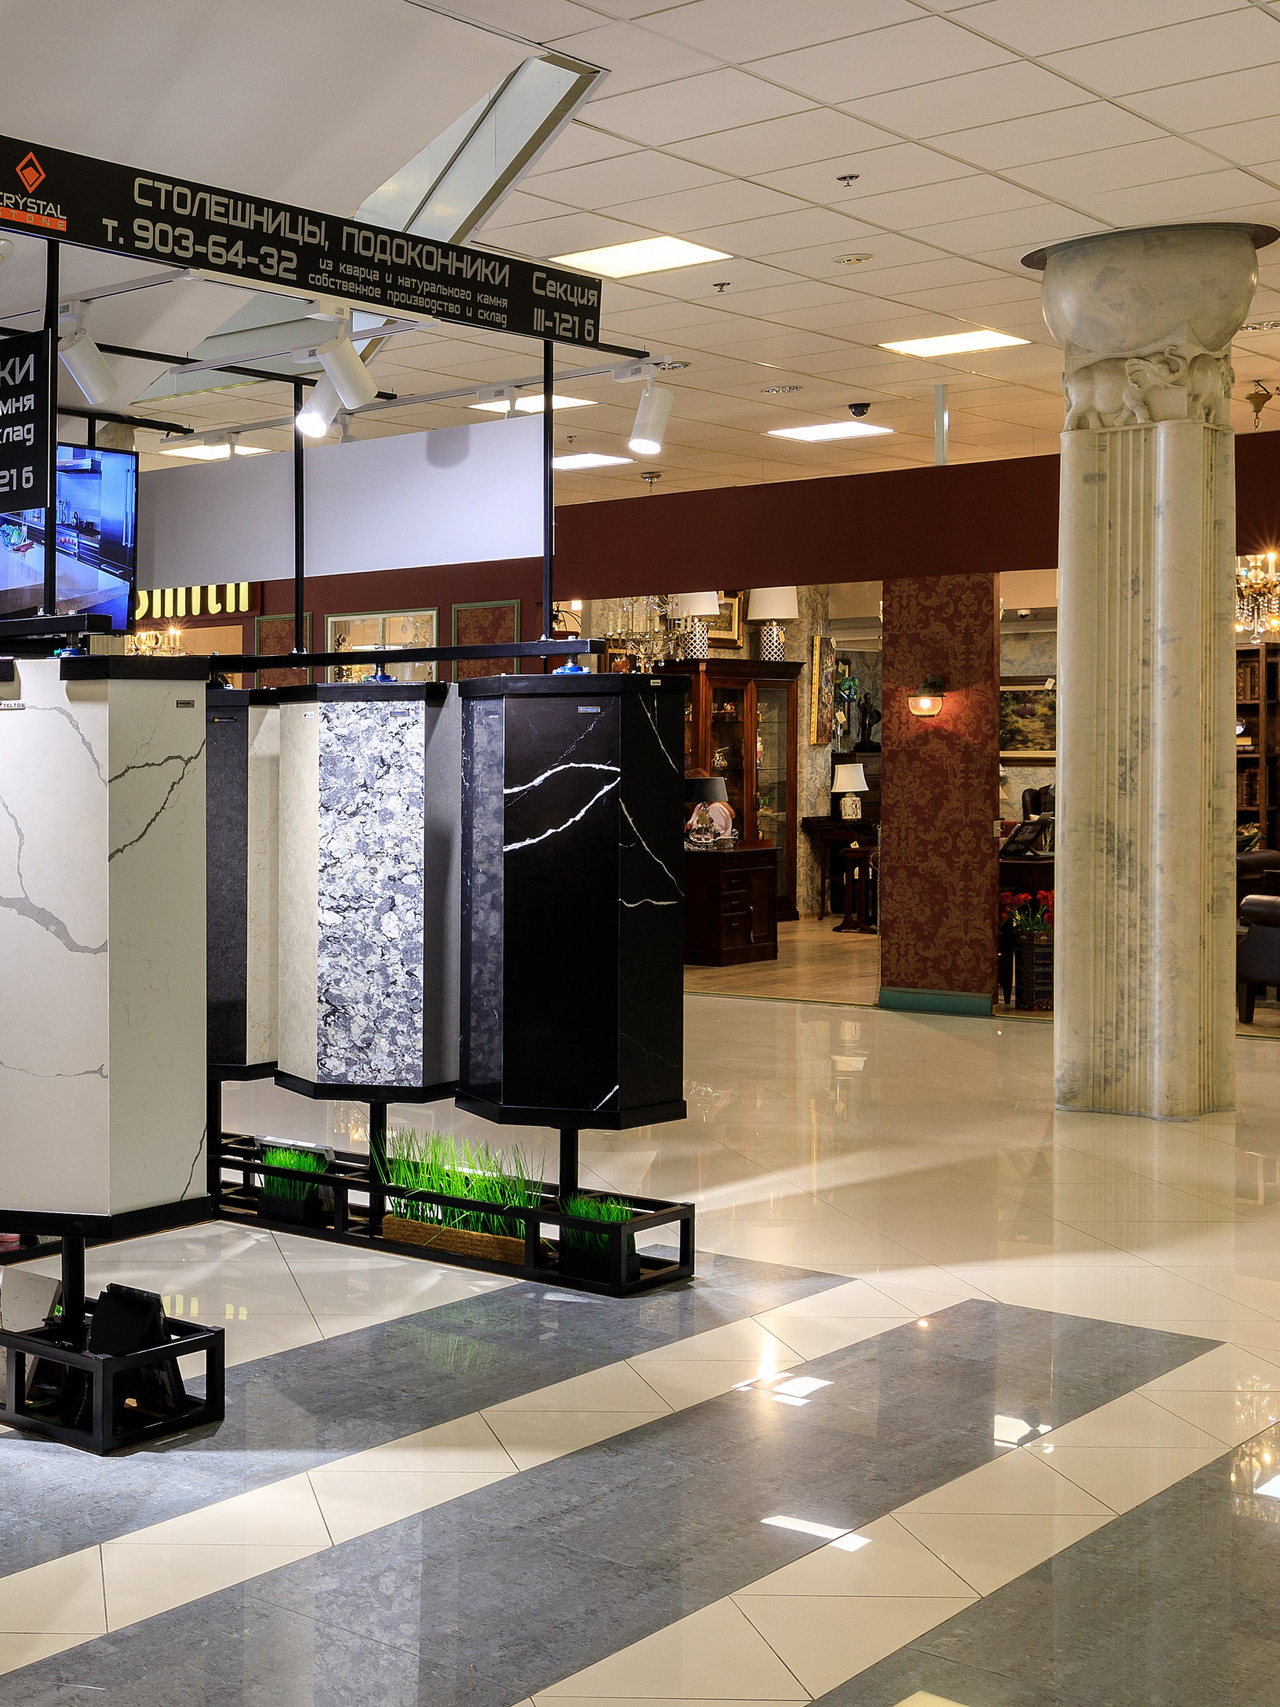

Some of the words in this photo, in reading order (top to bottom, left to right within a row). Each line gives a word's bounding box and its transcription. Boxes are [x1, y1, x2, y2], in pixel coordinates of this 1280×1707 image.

[133, 177, 329, 251] СТОЛЕШНИЦЫ,
[342, 225, 510, 288] ПОДОКОННИКИ
[133, 217, 298, 281] 903-64-32
[308, 273, 381, 298] собственное
[387, 288, 461, 316] производство
[466, 305, 473, 317] и
[477, 309, 507, 328] склад
[319, 257, 333, 270] из
[339, 261, 380, 284] кварца
[385, 272, 393, 284] и
[397, 275, 472, 301] натурального
[477, 292, 508, 308] камня
[532, 271, 598, 307] Секция
